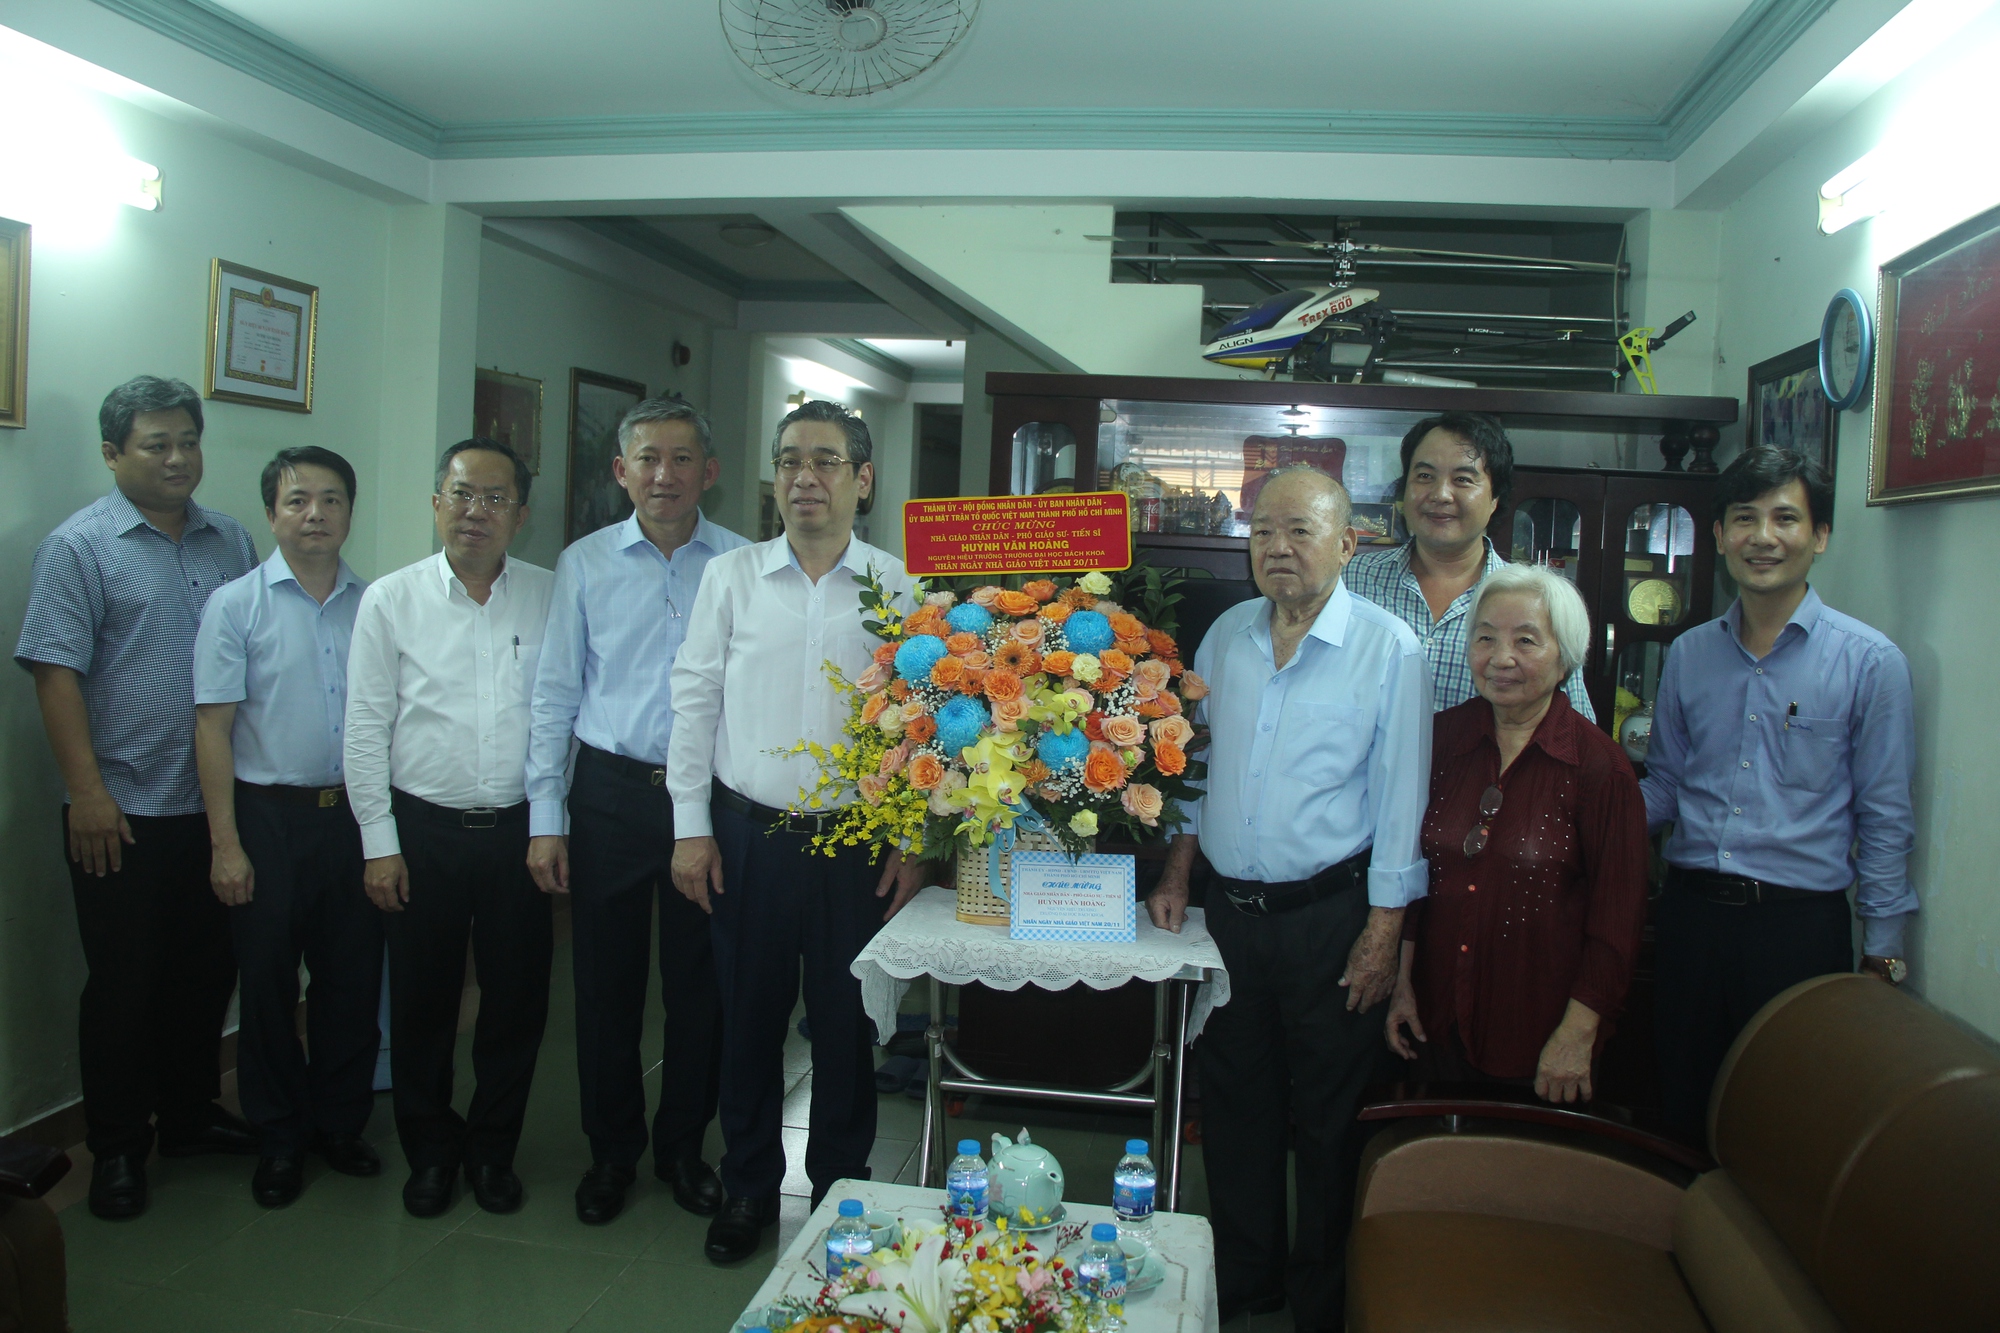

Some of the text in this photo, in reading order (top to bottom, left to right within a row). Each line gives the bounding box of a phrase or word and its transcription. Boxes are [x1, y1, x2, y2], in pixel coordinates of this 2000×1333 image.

[1330, 298, 1353, 315] 600
[1218, 337, 1253, 350] ALIGN
[923, 503, 946, 512] THÀNH
[948, 502, 956, 511] ỦY
[963, 502, 974, 512] HỘI
[976, 500, 995, 510] ĐỒNG
[997, 500, 1015, 509] NHÂN
[1018, 500, 1032, 508] DÂN
[1038, 498, 1048, 508] ỦY
[1066, 498, 1085, 507] NHÂN
[1087, 497, 1101, 506] DÂN
[909, 514, 918, 523] ỦY
[935, 515, 948, 523] MẶT
[951, 513, 969, 522] TRẬN
[971, 511, 980, 520] TỔ
[982, 511, 1000, 521] QUỐC
[1002, 511, 1017, 520] VIỆT
[1036, 509, 1060, 518] THÀNH
[1062, 508, 1076, 516] PHỐ
[1078, 508, 1088, 516] HỒ
[1090, 507, 1102, 516] CHÍ
[1104, 507, 1122, 515] MINH
[972, 520, 1056, 531] CHÚC MỪNG
[931, 534, 946, 542] NHÀ
[949, 533, 967, 541] GIÁO
[970, 532, 990, 540] NHÂN
[1017, 531, 1032, 539] PHÓ
[1035, 530, 1054, 538] GIÁO
[1072, 528, 1090, 537] TIẾN
[1093, 528, 1101, 536] SĨ
[962, 539, 1069, 552] HUỲNH VĂN HOÀNG
[935, 561, 958, 570] NHÂN
[960, 561, 982, 570] NGÀY
[986, 560, 1003, 568] NHÀ
[1006, 560, 1026, 568] GIÁO
[1029, 558, 1049, 568] VIỆT
